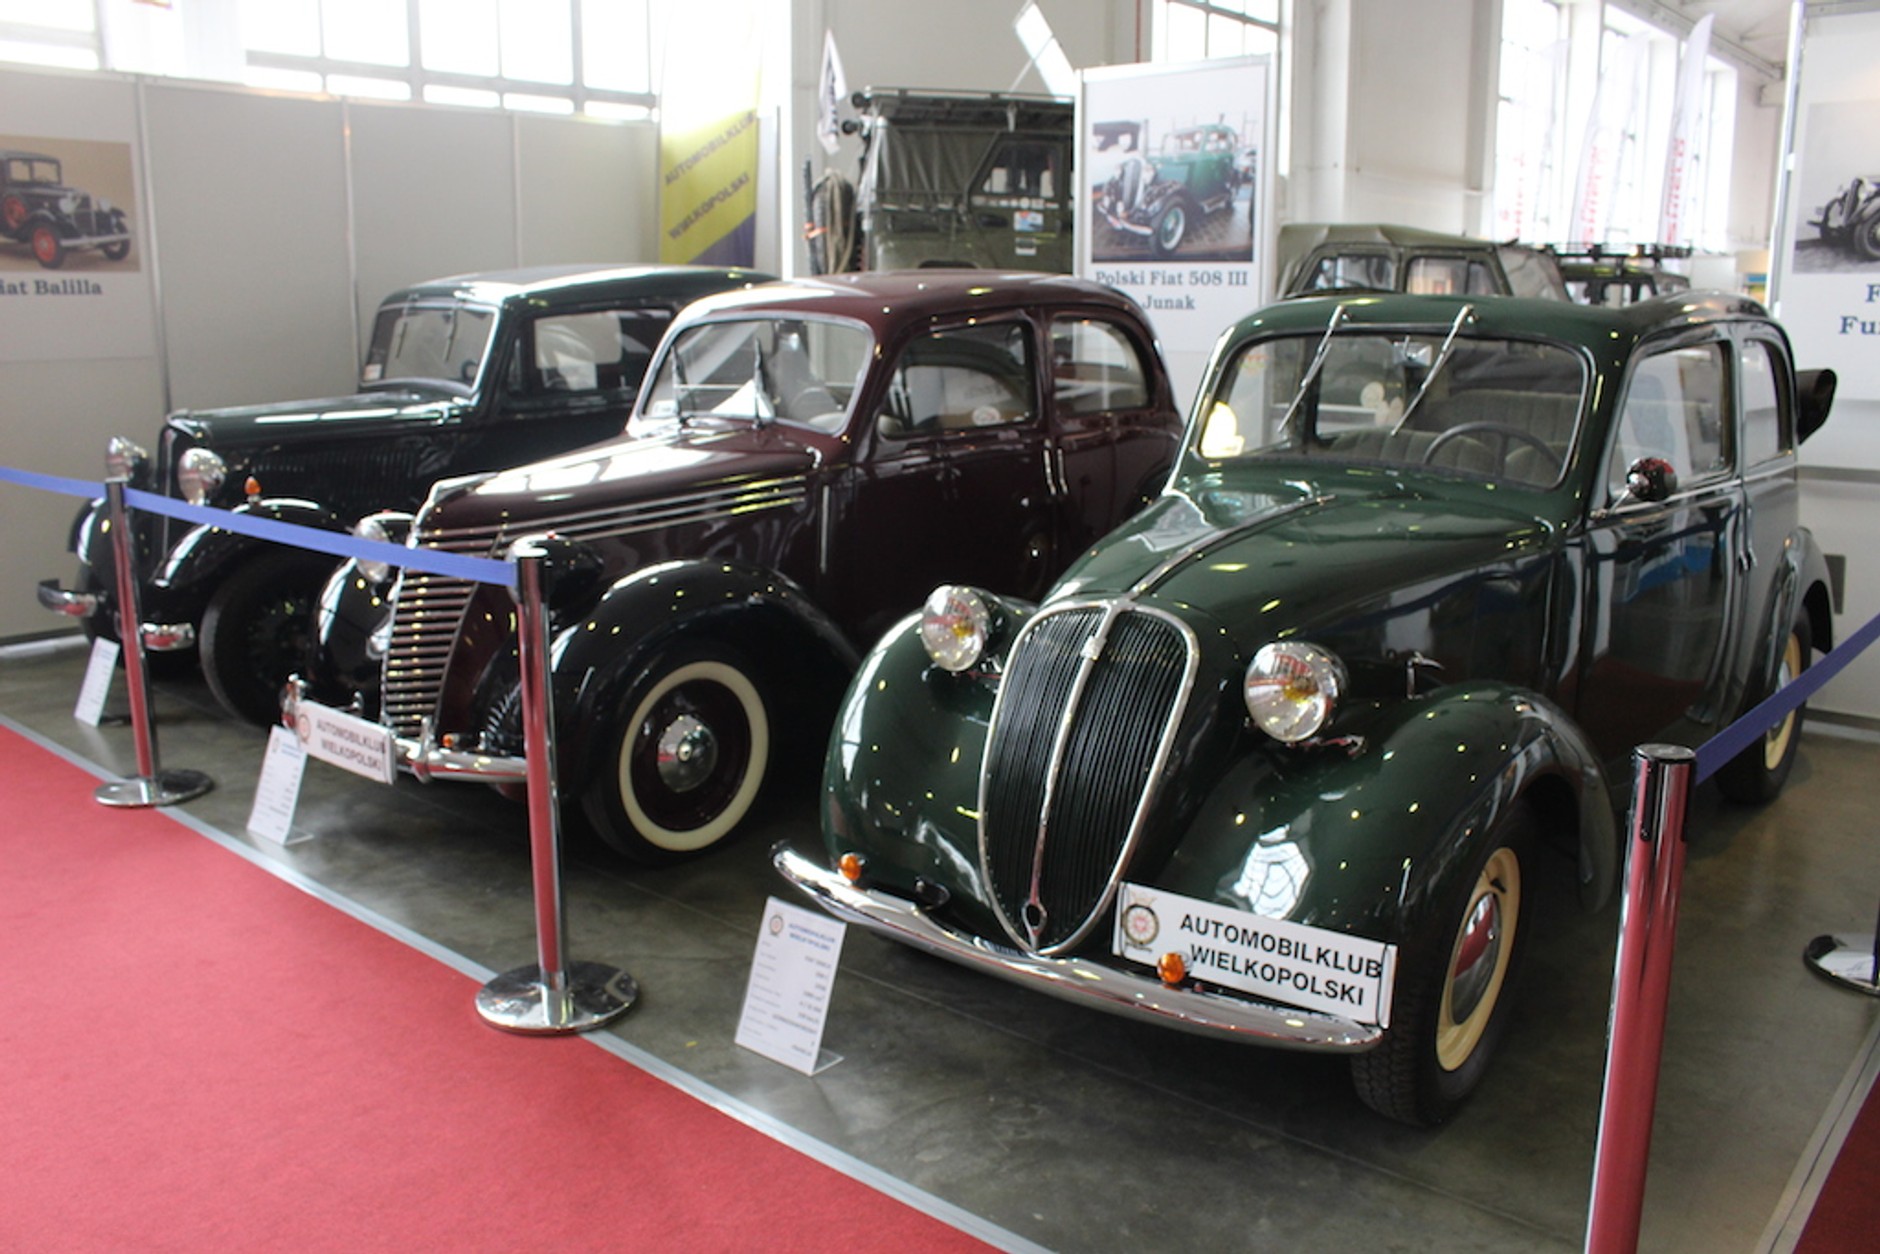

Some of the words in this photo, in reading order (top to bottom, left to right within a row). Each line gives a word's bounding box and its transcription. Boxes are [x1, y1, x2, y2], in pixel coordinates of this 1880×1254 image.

[34, 278, 102, 295] Balilla
[1096, 270, 1145, 286] Polski
[1150, 271, 1183, 285] Fiat
[1189, 271, 1222, 286] 508
[1228, 271, 1248, 285] III
[1142, 296, 1196, 310] Junak
[317, 719, 386, 754] AUTOMOBILKLUB
[1180, 913, 1382, 979] AUTOMOBILKLUB
[1190, 943, 1364, 1006] WIELKOPOLSKI
